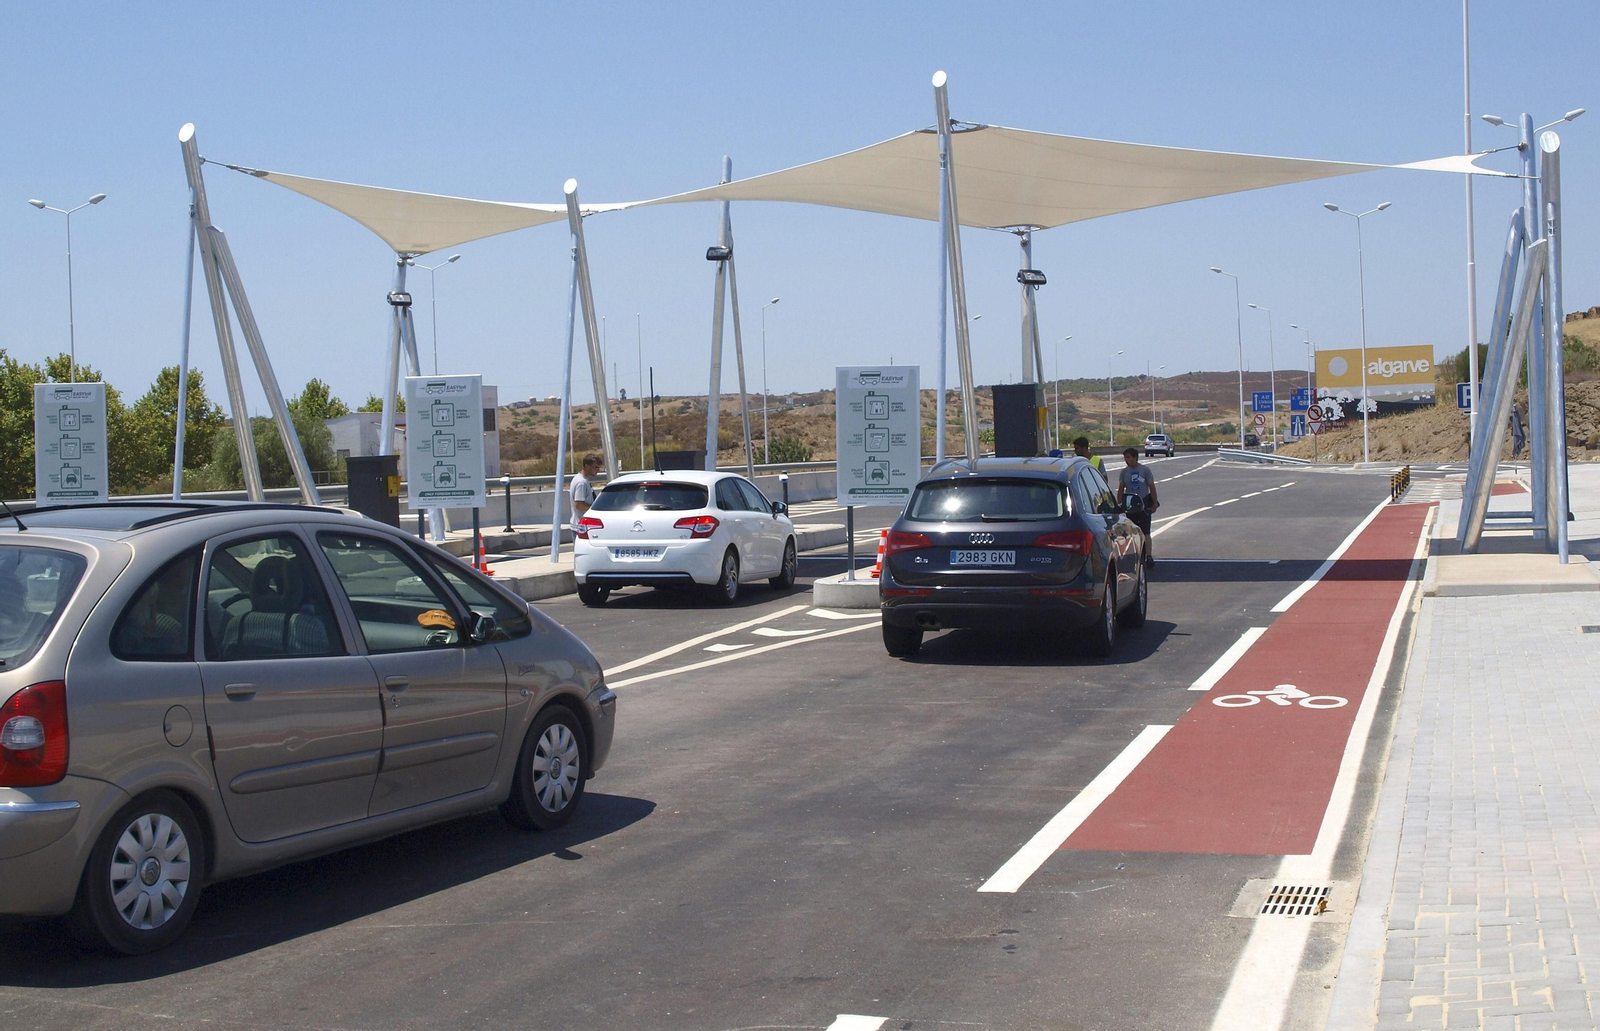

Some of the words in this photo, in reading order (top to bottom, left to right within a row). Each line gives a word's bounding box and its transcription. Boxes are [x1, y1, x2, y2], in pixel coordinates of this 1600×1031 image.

[1368, 358, 1430, 378] algarve
[958, 552, 987, 563] 2983
[990, 552, 1013, 563] GKN
